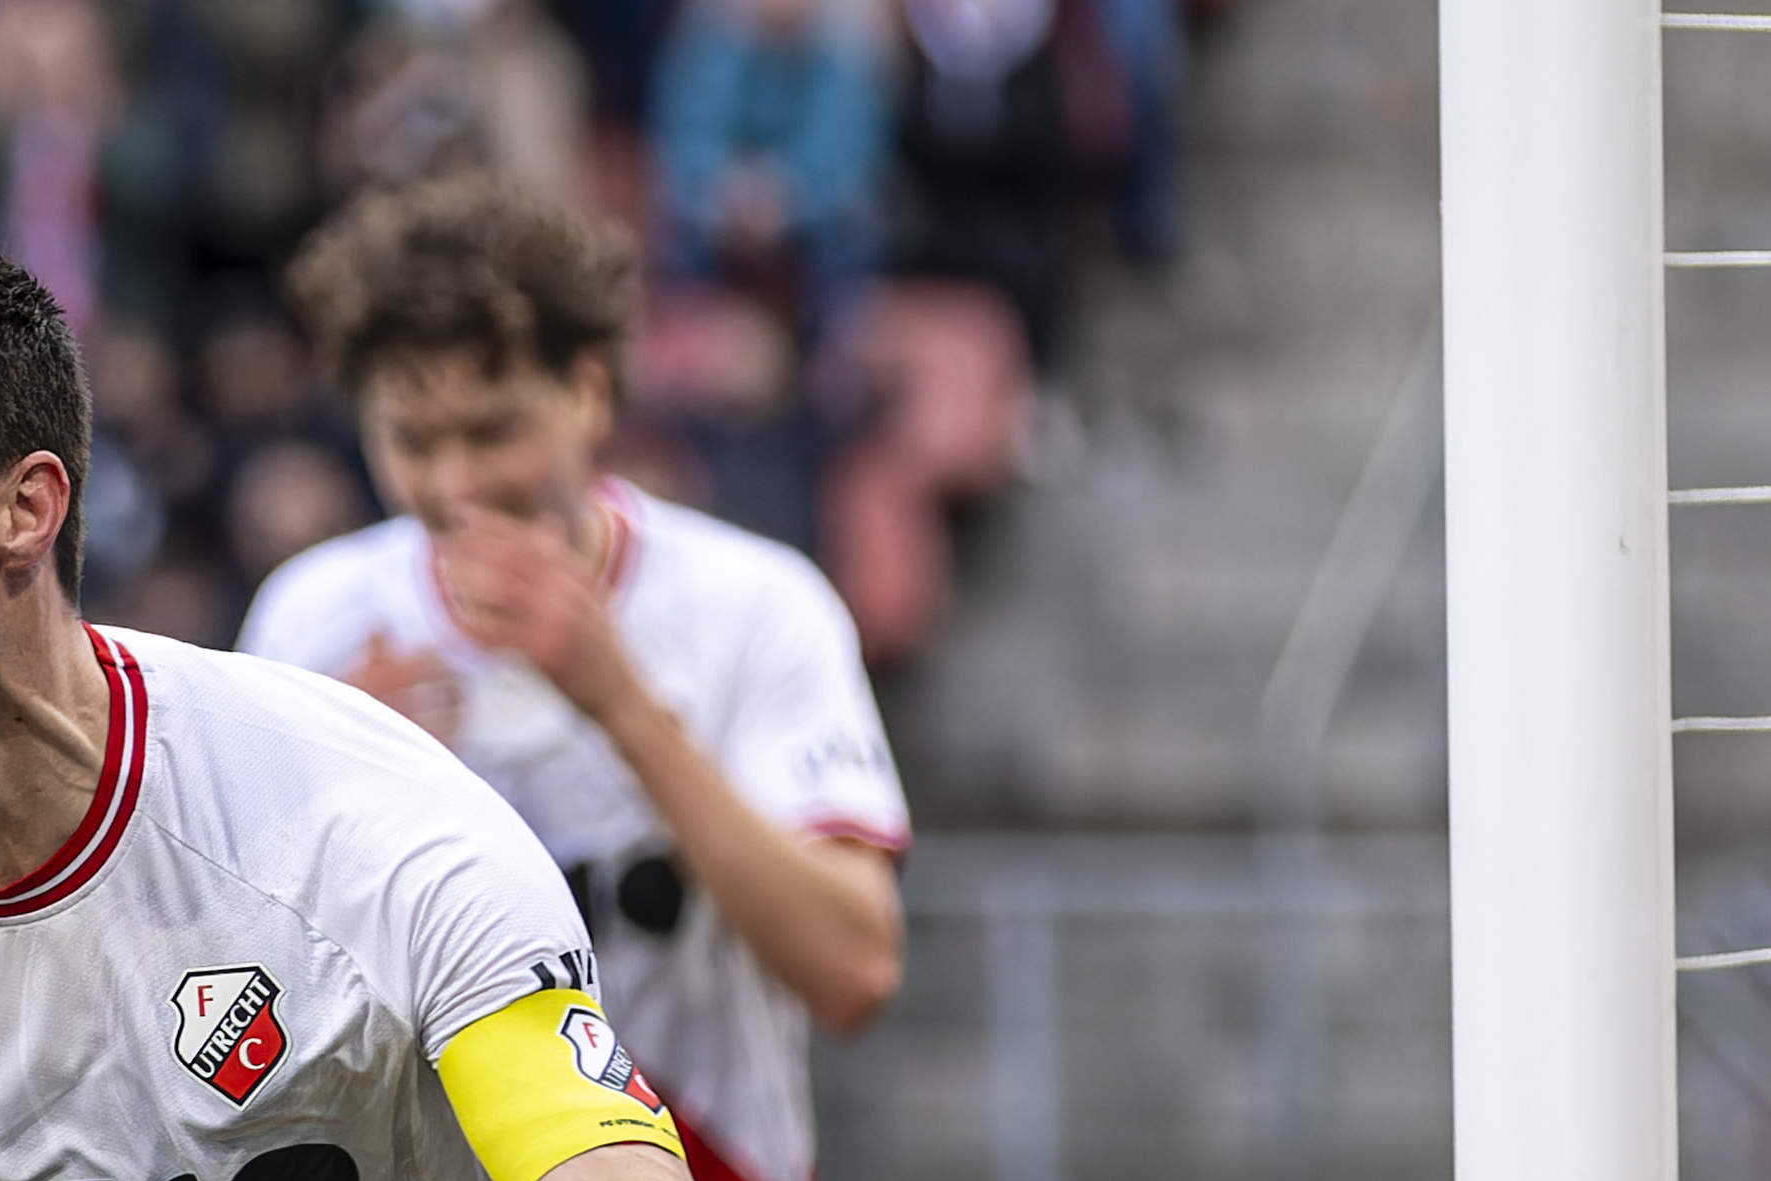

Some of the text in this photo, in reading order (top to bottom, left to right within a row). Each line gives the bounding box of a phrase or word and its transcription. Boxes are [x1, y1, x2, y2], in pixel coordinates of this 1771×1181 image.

[197, 984, 214, 1017] F
[190, 975, 271, 1079] UTRECHT
[582, 1021, 600, 1048] F
[238, 1037, 266, 1070] C
